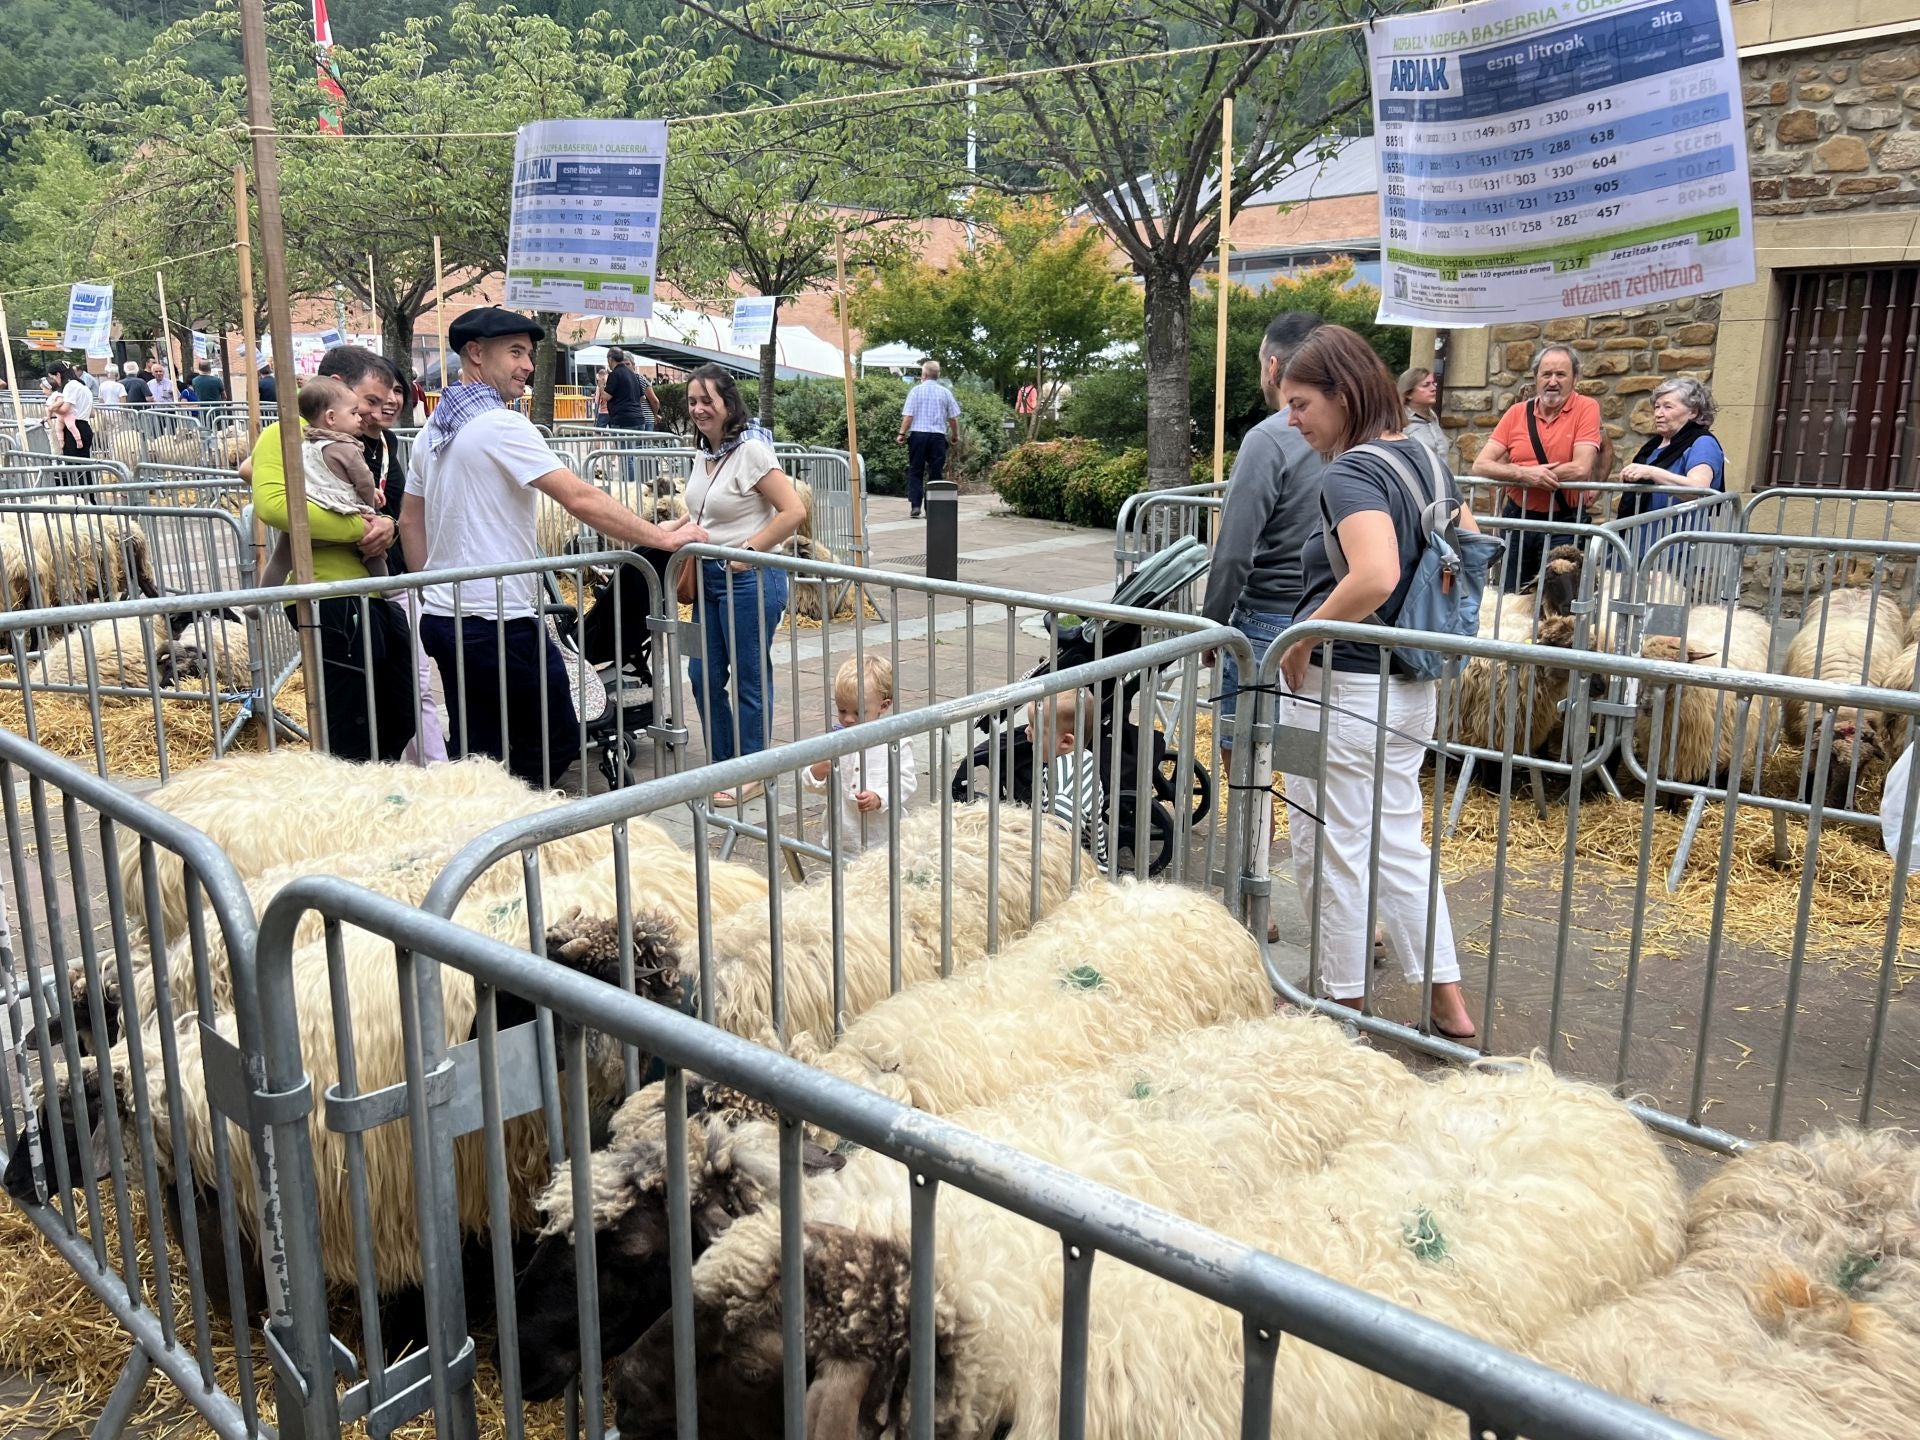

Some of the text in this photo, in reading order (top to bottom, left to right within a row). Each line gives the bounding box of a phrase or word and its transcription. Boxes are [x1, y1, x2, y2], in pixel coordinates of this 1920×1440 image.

[1472, 8, 1558, 42] BASERRIA
[1651, 10, 1684, 29] aita
[1487, 33, 1585, 71] esne litroak
[1390, 56, 1450, 92] ARDIAK
[1477, 126, 1495, 139] 149
[1510, 118, 1531, 133] 373
[1546, 110, 1569, 125] 330
[1587, 98, 1612, 114] 913
[1480, 155, 1497, 167] 131
[1513, 148, 1534, 162] 275
[1549, 140, 1571, 154] 288
[1590, 129, 1614, 144] 638
[562, 165, 602, 175] esne litroak
[628, 166, 642, 176] aita
[1459, 184, 1463, 192] 3
[1484, 179, 1500, 191] 131
[1516, 172, 1536, 186] 303
[1551, 165, 1573, 179] 330
[1592, 154, 1617, 169] 604
[593, 199, 603, 207] 207
[1461, 207, 1466, 215] 4
[1486, 203, 1503, 214] 131
[1519, 197, 1538, 210] 231
[1554, 190, 1576, 203] 233
[1594, 180, 1619, 195] 905
[1464, 230, 1469, 238] 2
[1489, 226, 1506, 237] 131
[1522, 220, 1542, 233] 258
[1556, 214, 1578, 227] 282
[1597, 204, 1621, 219] 457
[1610, 226, 1732, 261] Jetzitako esnea: 207
[1443, 257, 1473, 268] besteko
[1475, 254, 1520, 267] emaitzak:
[1443, 270, 1458, 281] 122
[1493, 269, 1528, 279] egunetako
[1529, 265, 1551, 274] esnea
[1559, 257, 1584, 272] 237
[1561, 262, 1705, 307] artzaien zerbitzura
